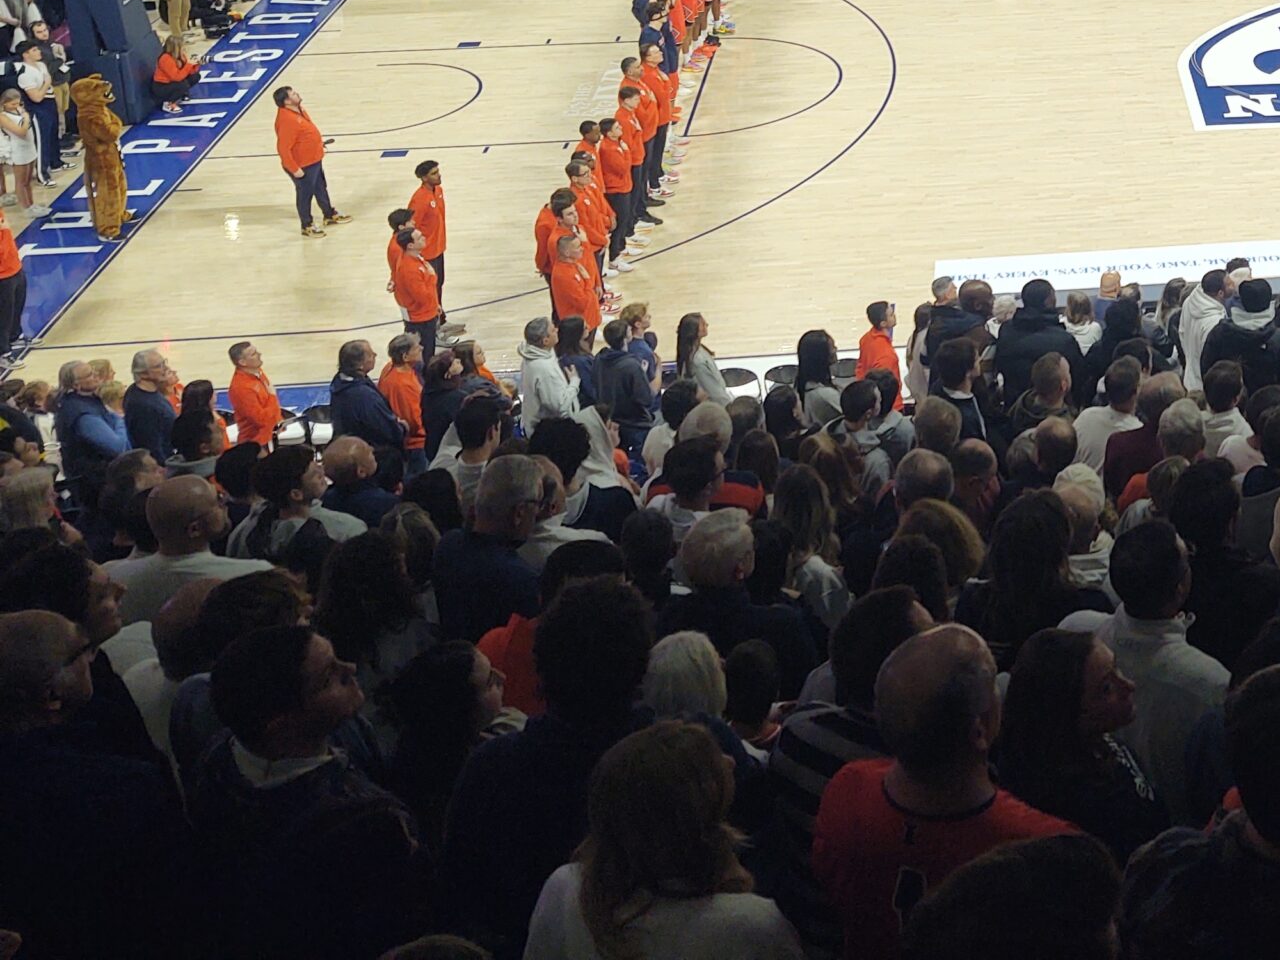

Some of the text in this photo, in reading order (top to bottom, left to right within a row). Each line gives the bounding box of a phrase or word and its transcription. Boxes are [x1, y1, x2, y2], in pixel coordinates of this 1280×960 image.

[1105, 261, 1152, 273] YOUR
[1155, 258, 1202, 270] TAKE
[992, 268, 1050, 279] EVERY
